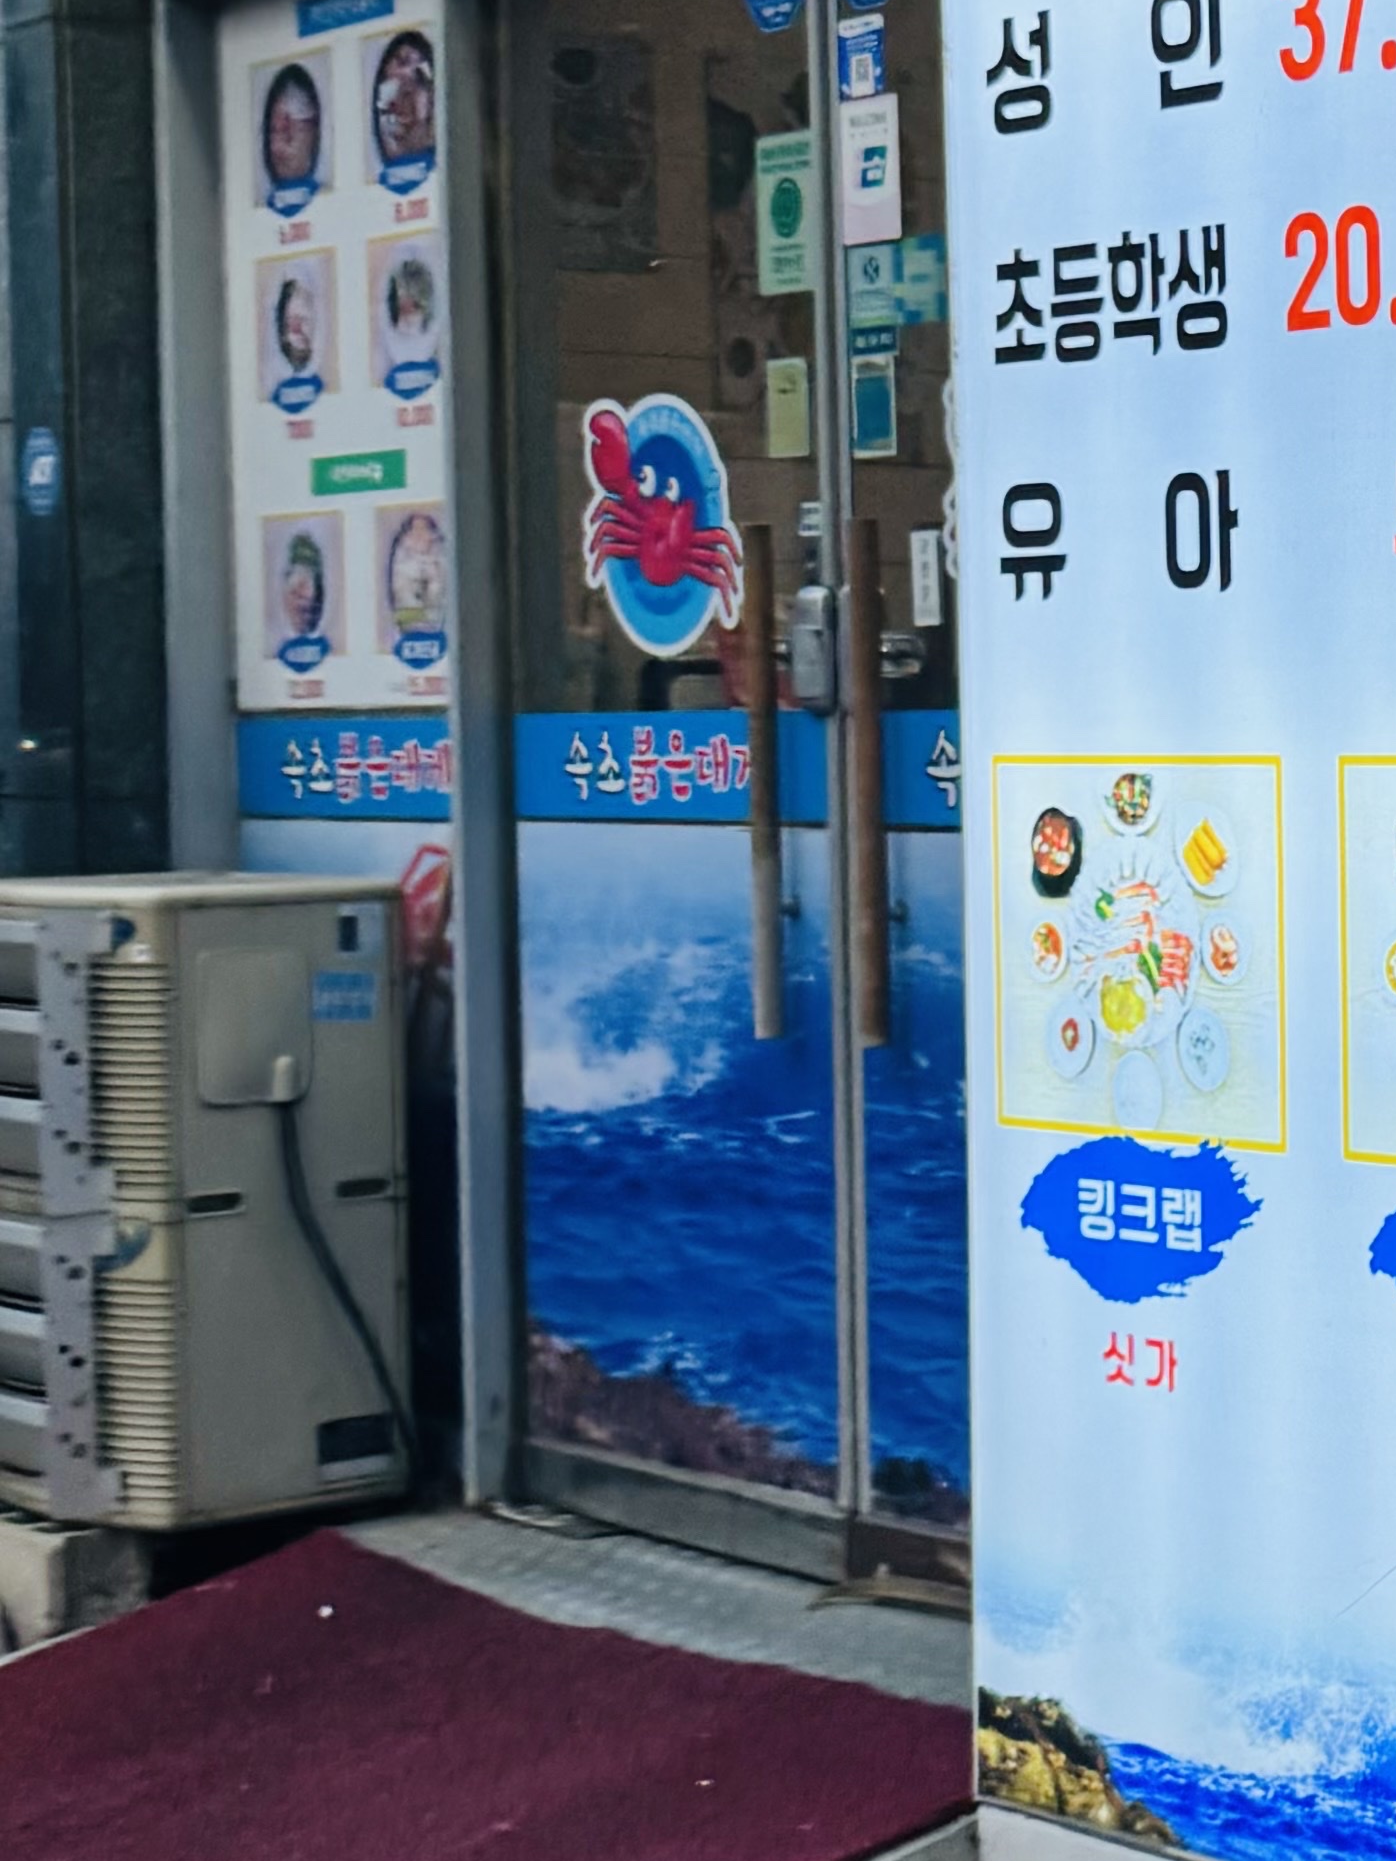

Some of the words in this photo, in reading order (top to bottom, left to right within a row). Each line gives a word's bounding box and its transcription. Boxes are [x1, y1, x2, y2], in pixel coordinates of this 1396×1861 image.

[995, 223, 1229, 364] 초등학생
[1076, 1177, 1203, 1254] 킹크랩
[1102, 1331, 1179, 1393] 싯가
